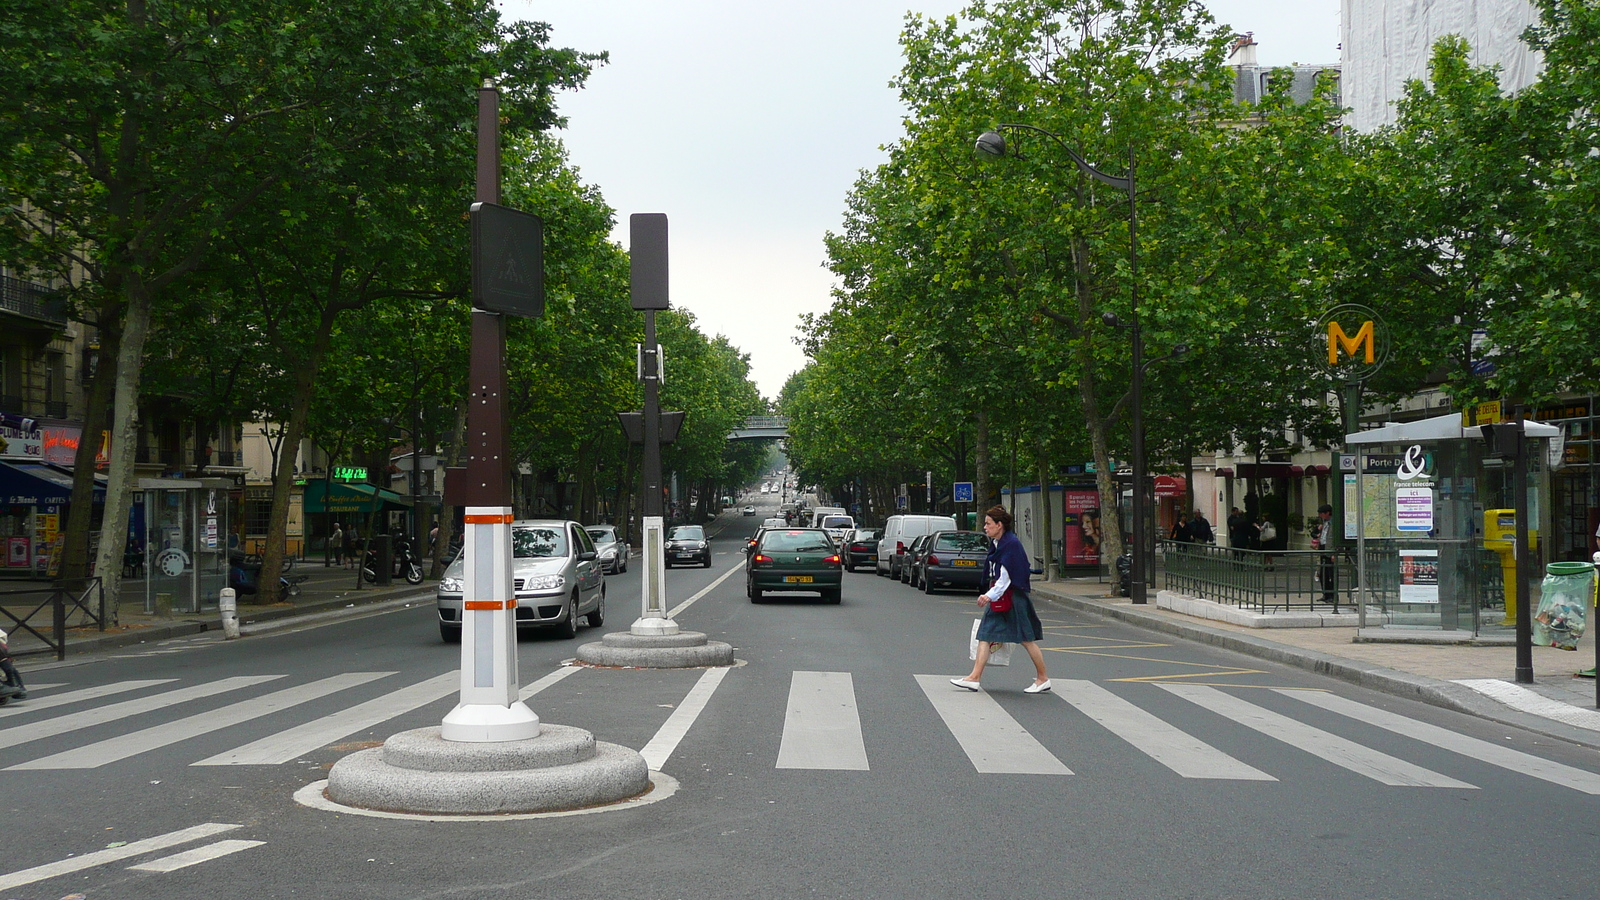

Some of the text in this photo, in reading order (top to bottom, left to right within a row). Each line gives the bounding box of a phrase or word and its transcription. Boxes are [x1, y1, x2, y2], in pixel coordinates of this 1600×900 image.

[1328, 320, 1375, 365] M
[1370, 459, 1392, 467] Porte
[44, 496, 66, 504] CARTES
